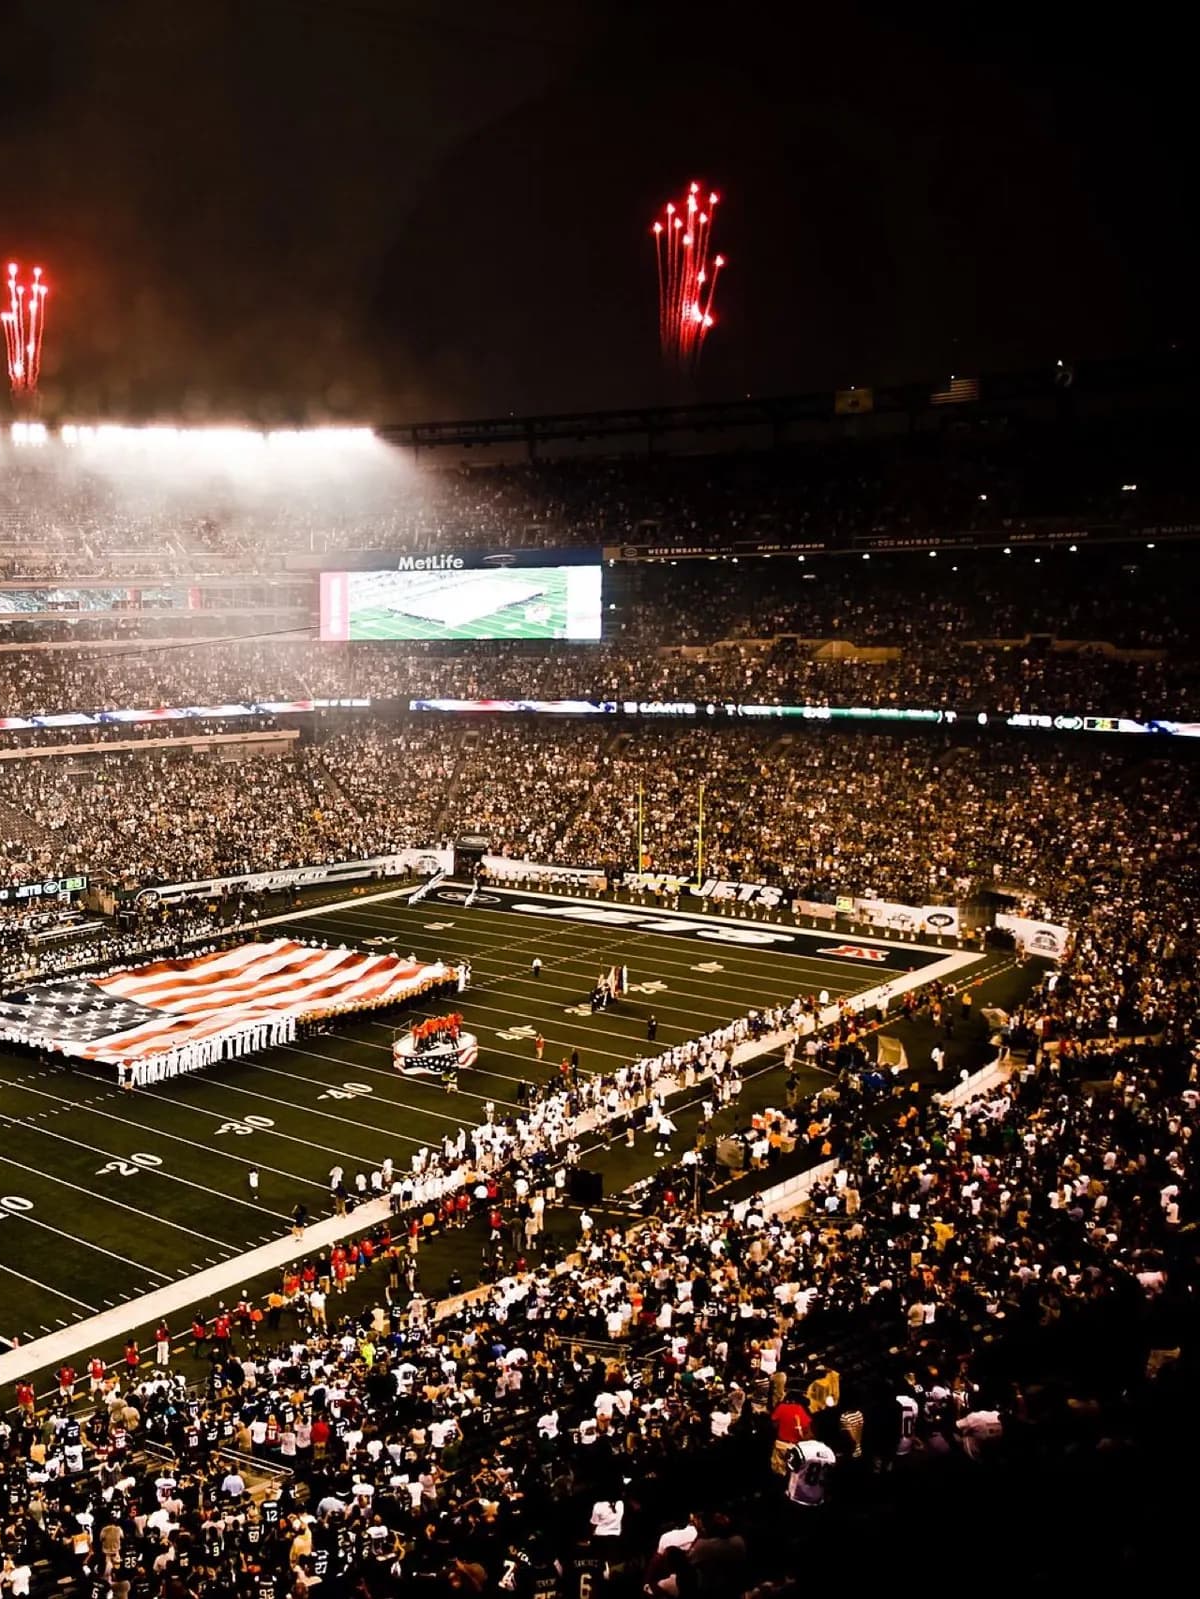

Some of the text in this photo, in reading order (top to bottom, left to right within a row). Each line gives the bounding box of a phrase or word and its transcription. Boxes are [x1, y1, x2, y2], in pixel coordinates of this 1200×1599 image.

[398, 554, 464, 570] MetLife
[16, 884, 42, 898] JETS
[511, 904, 795, 944] JETS
[326, 1083, 373, 1100] 40
[221, 1115, 275, 1136] 30
[106, 1153, 163, 1177] 20
[266, 1510, 278, 1523] 12
